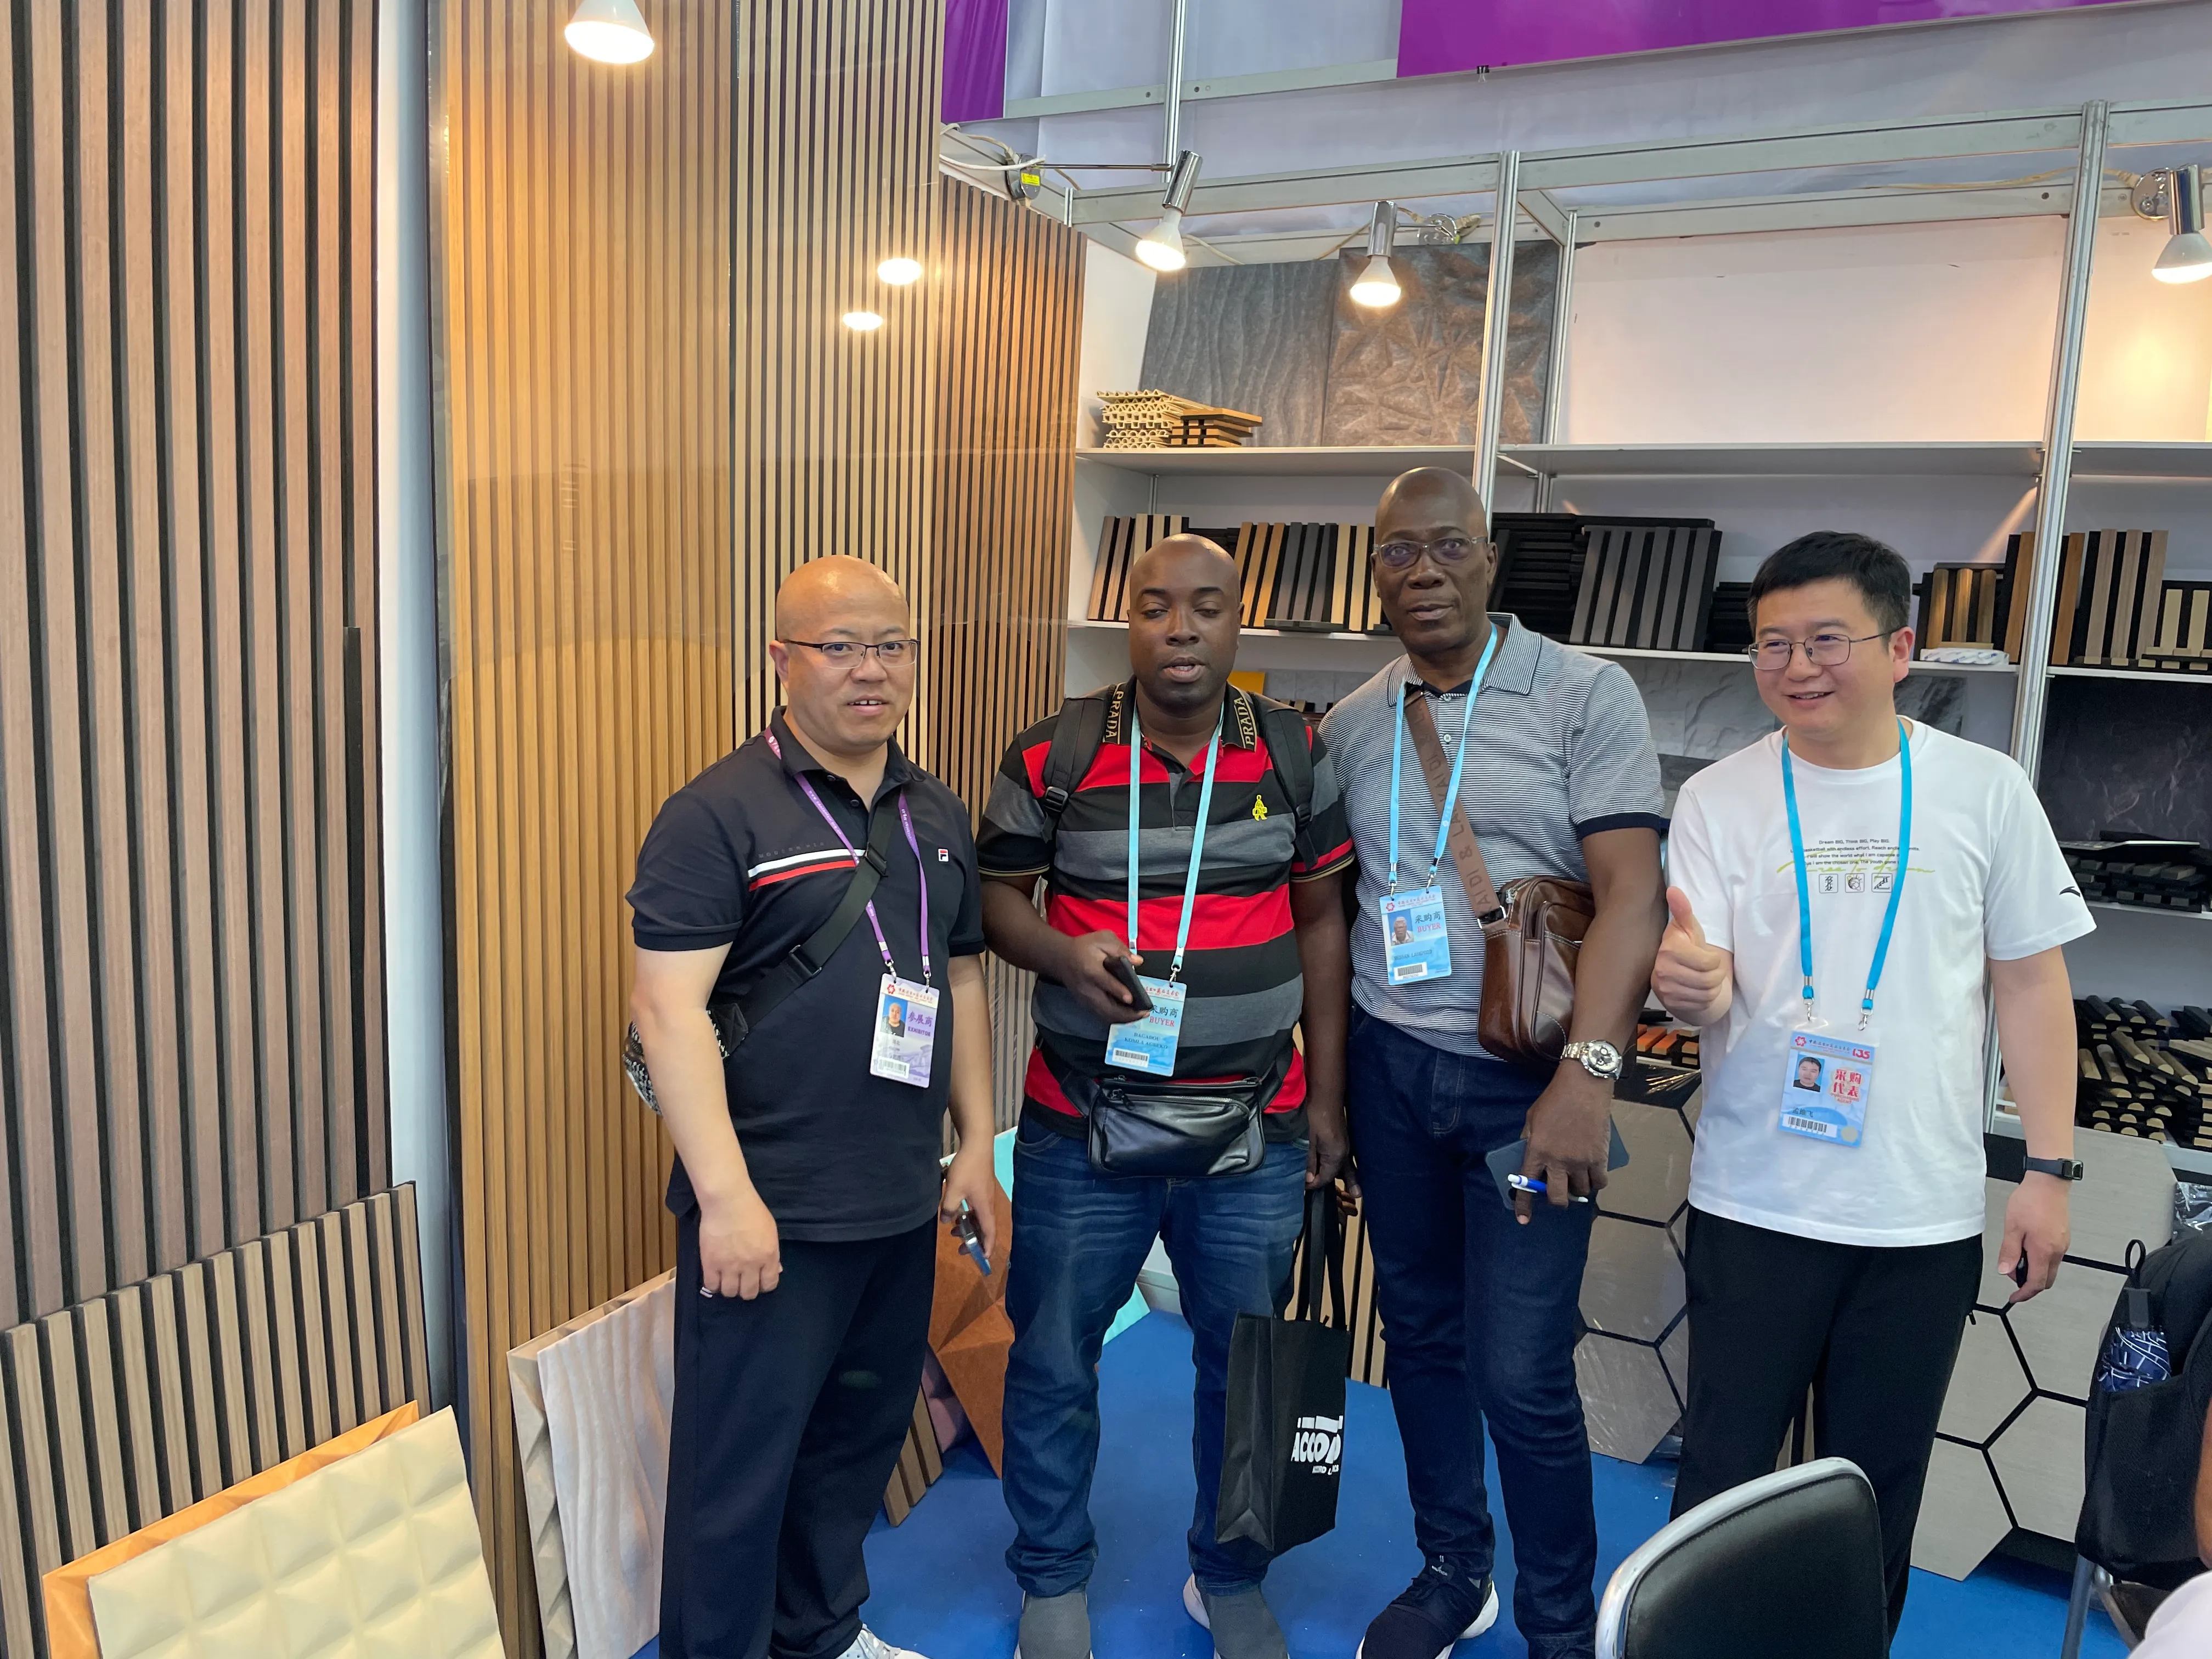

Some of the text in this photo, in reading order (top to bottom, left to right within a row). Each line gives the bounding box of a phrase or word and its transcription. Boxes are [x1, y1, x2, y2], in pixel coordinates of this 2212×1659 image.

[1105, 691, 1124, 738] PRADA
[1233, 696, 1255, 746] PRADA
[1415, 911, 1441, 924] 采购商
[1417, 923, 1441, 933] BUYER
[907, 1011, 933, 1027] 参展商
[1149, 1016, 1175, 1027] BUYER
[908, 1026, 931, 1037] EXHIBITOR
[1835, 1069, 1861, 1085] 采购
[1833, 1082, 1859, 1097] 代表
